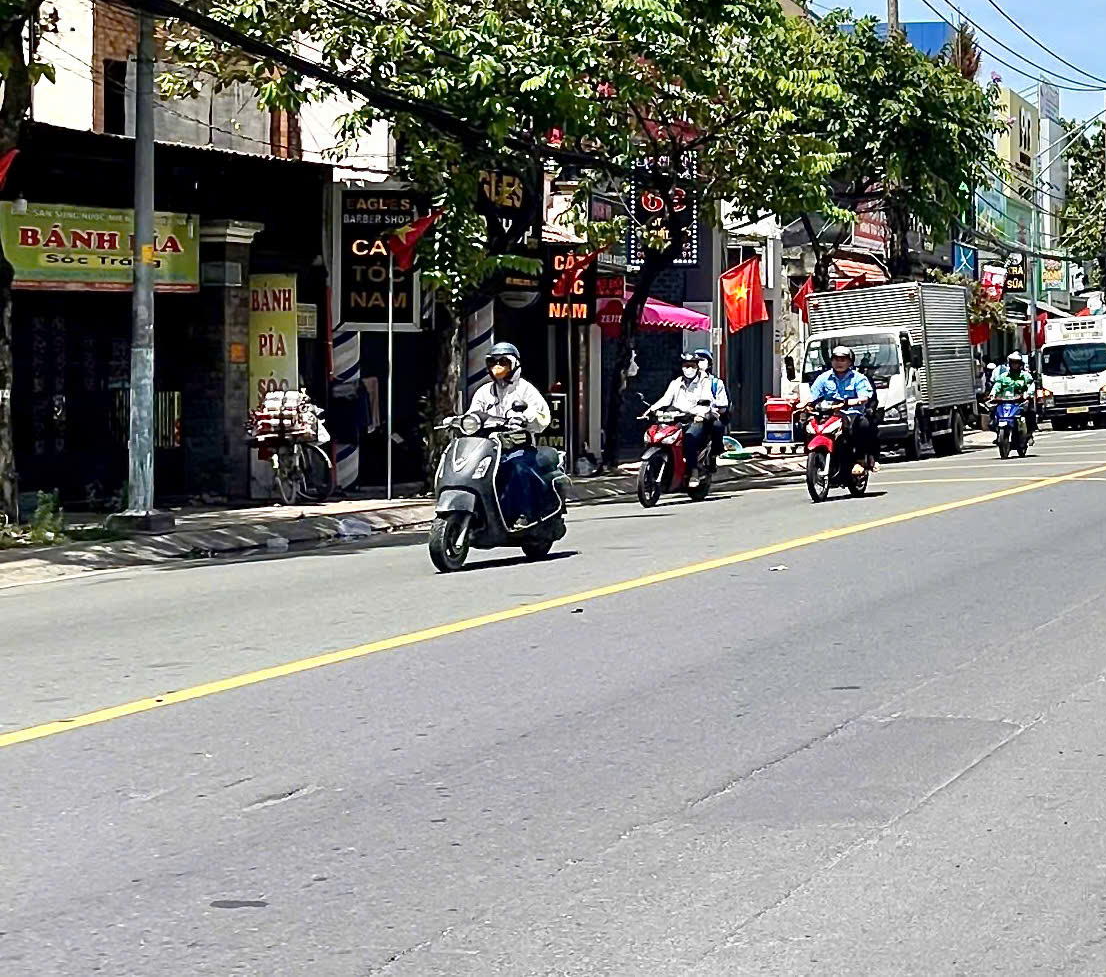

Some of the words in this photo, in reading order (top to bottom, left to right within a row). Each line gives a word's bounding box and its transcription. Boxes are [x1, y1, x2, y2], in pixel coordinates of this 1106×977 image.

[343, 213, 382, 224] BARBER
[18, 222, 121, 251] BÁNH
[250, 281, 293, 312] BÁNH
[548, 302, 588, 319] NAM
[258, 326, 287, 357] PÍA
[538, 435, 564, 447] AM
